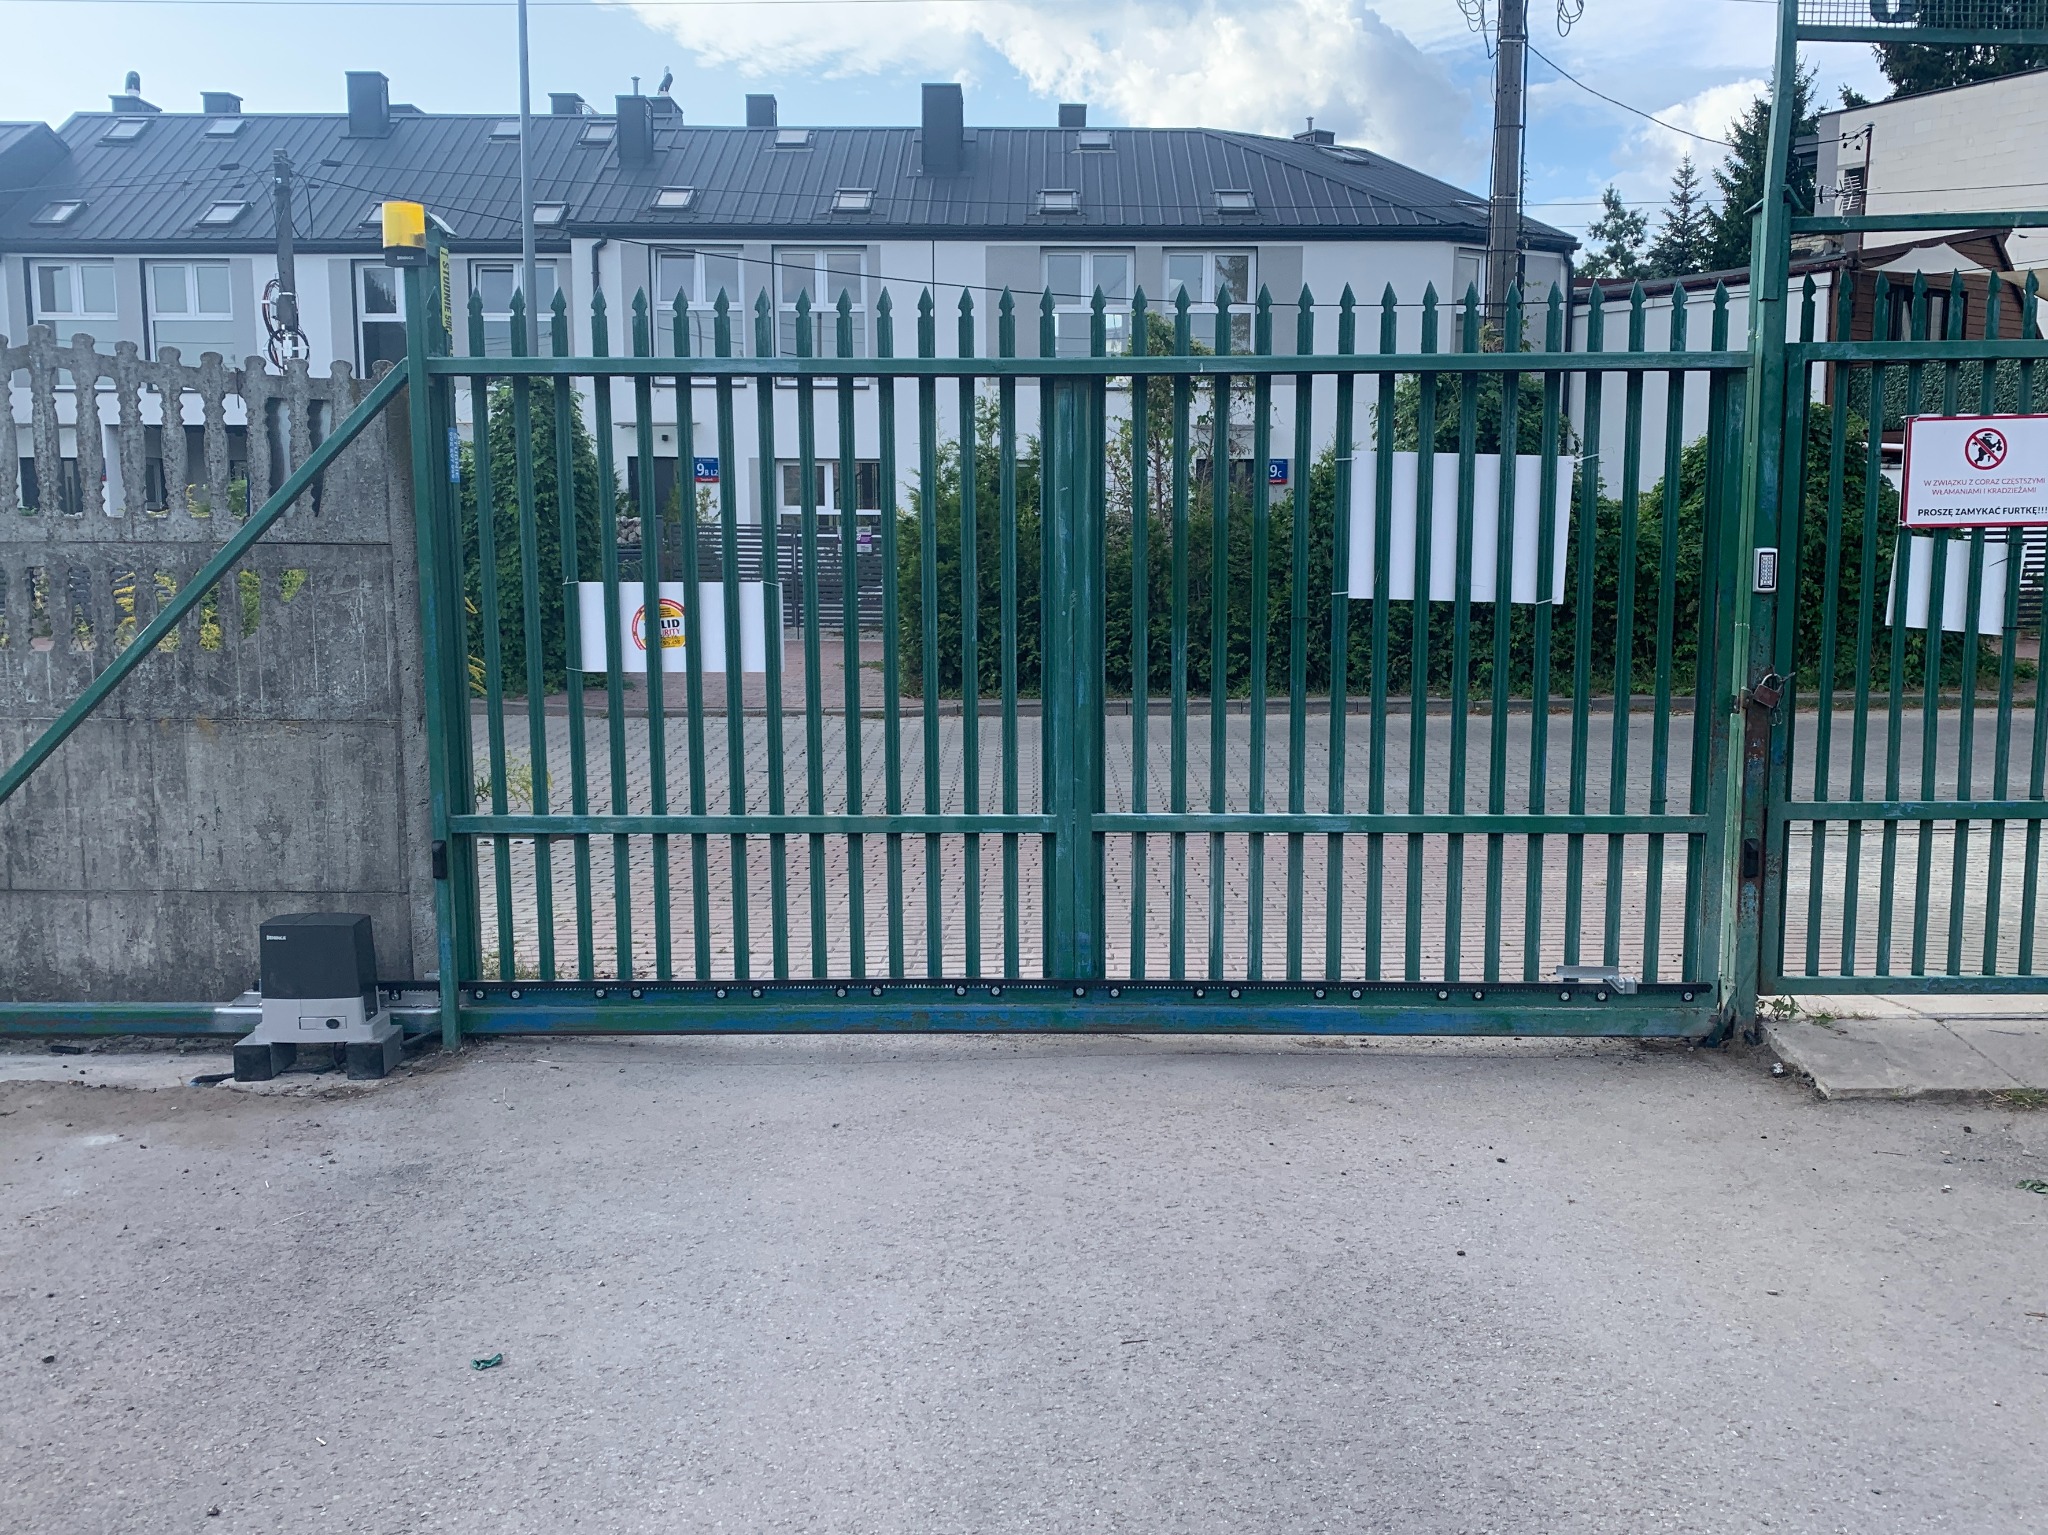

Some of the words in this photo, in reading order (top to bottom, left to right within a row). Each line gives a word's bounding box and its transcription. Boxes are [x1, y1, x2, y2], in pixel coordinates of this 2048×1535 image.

[442, 261, 451, 314] STUDNIE
[1932, 479, 1967, 487] ZWIĄZKU
[1974, 478, 2001, 486] CORAZ
[2001, 477, 2046, 486] CZĘSTSZYMI
[1932, 488, 1982, 496] WŁAMANIAMI
[1987, 486, 2037, 495] KRADZIEŻAMI
[1917, 508, 1954, 517] PROSZĘ
[1956, 505, 2001, 516] ZAMYKAĆ
[2002, 506, 2048, 515] FURTKĘ!!!
